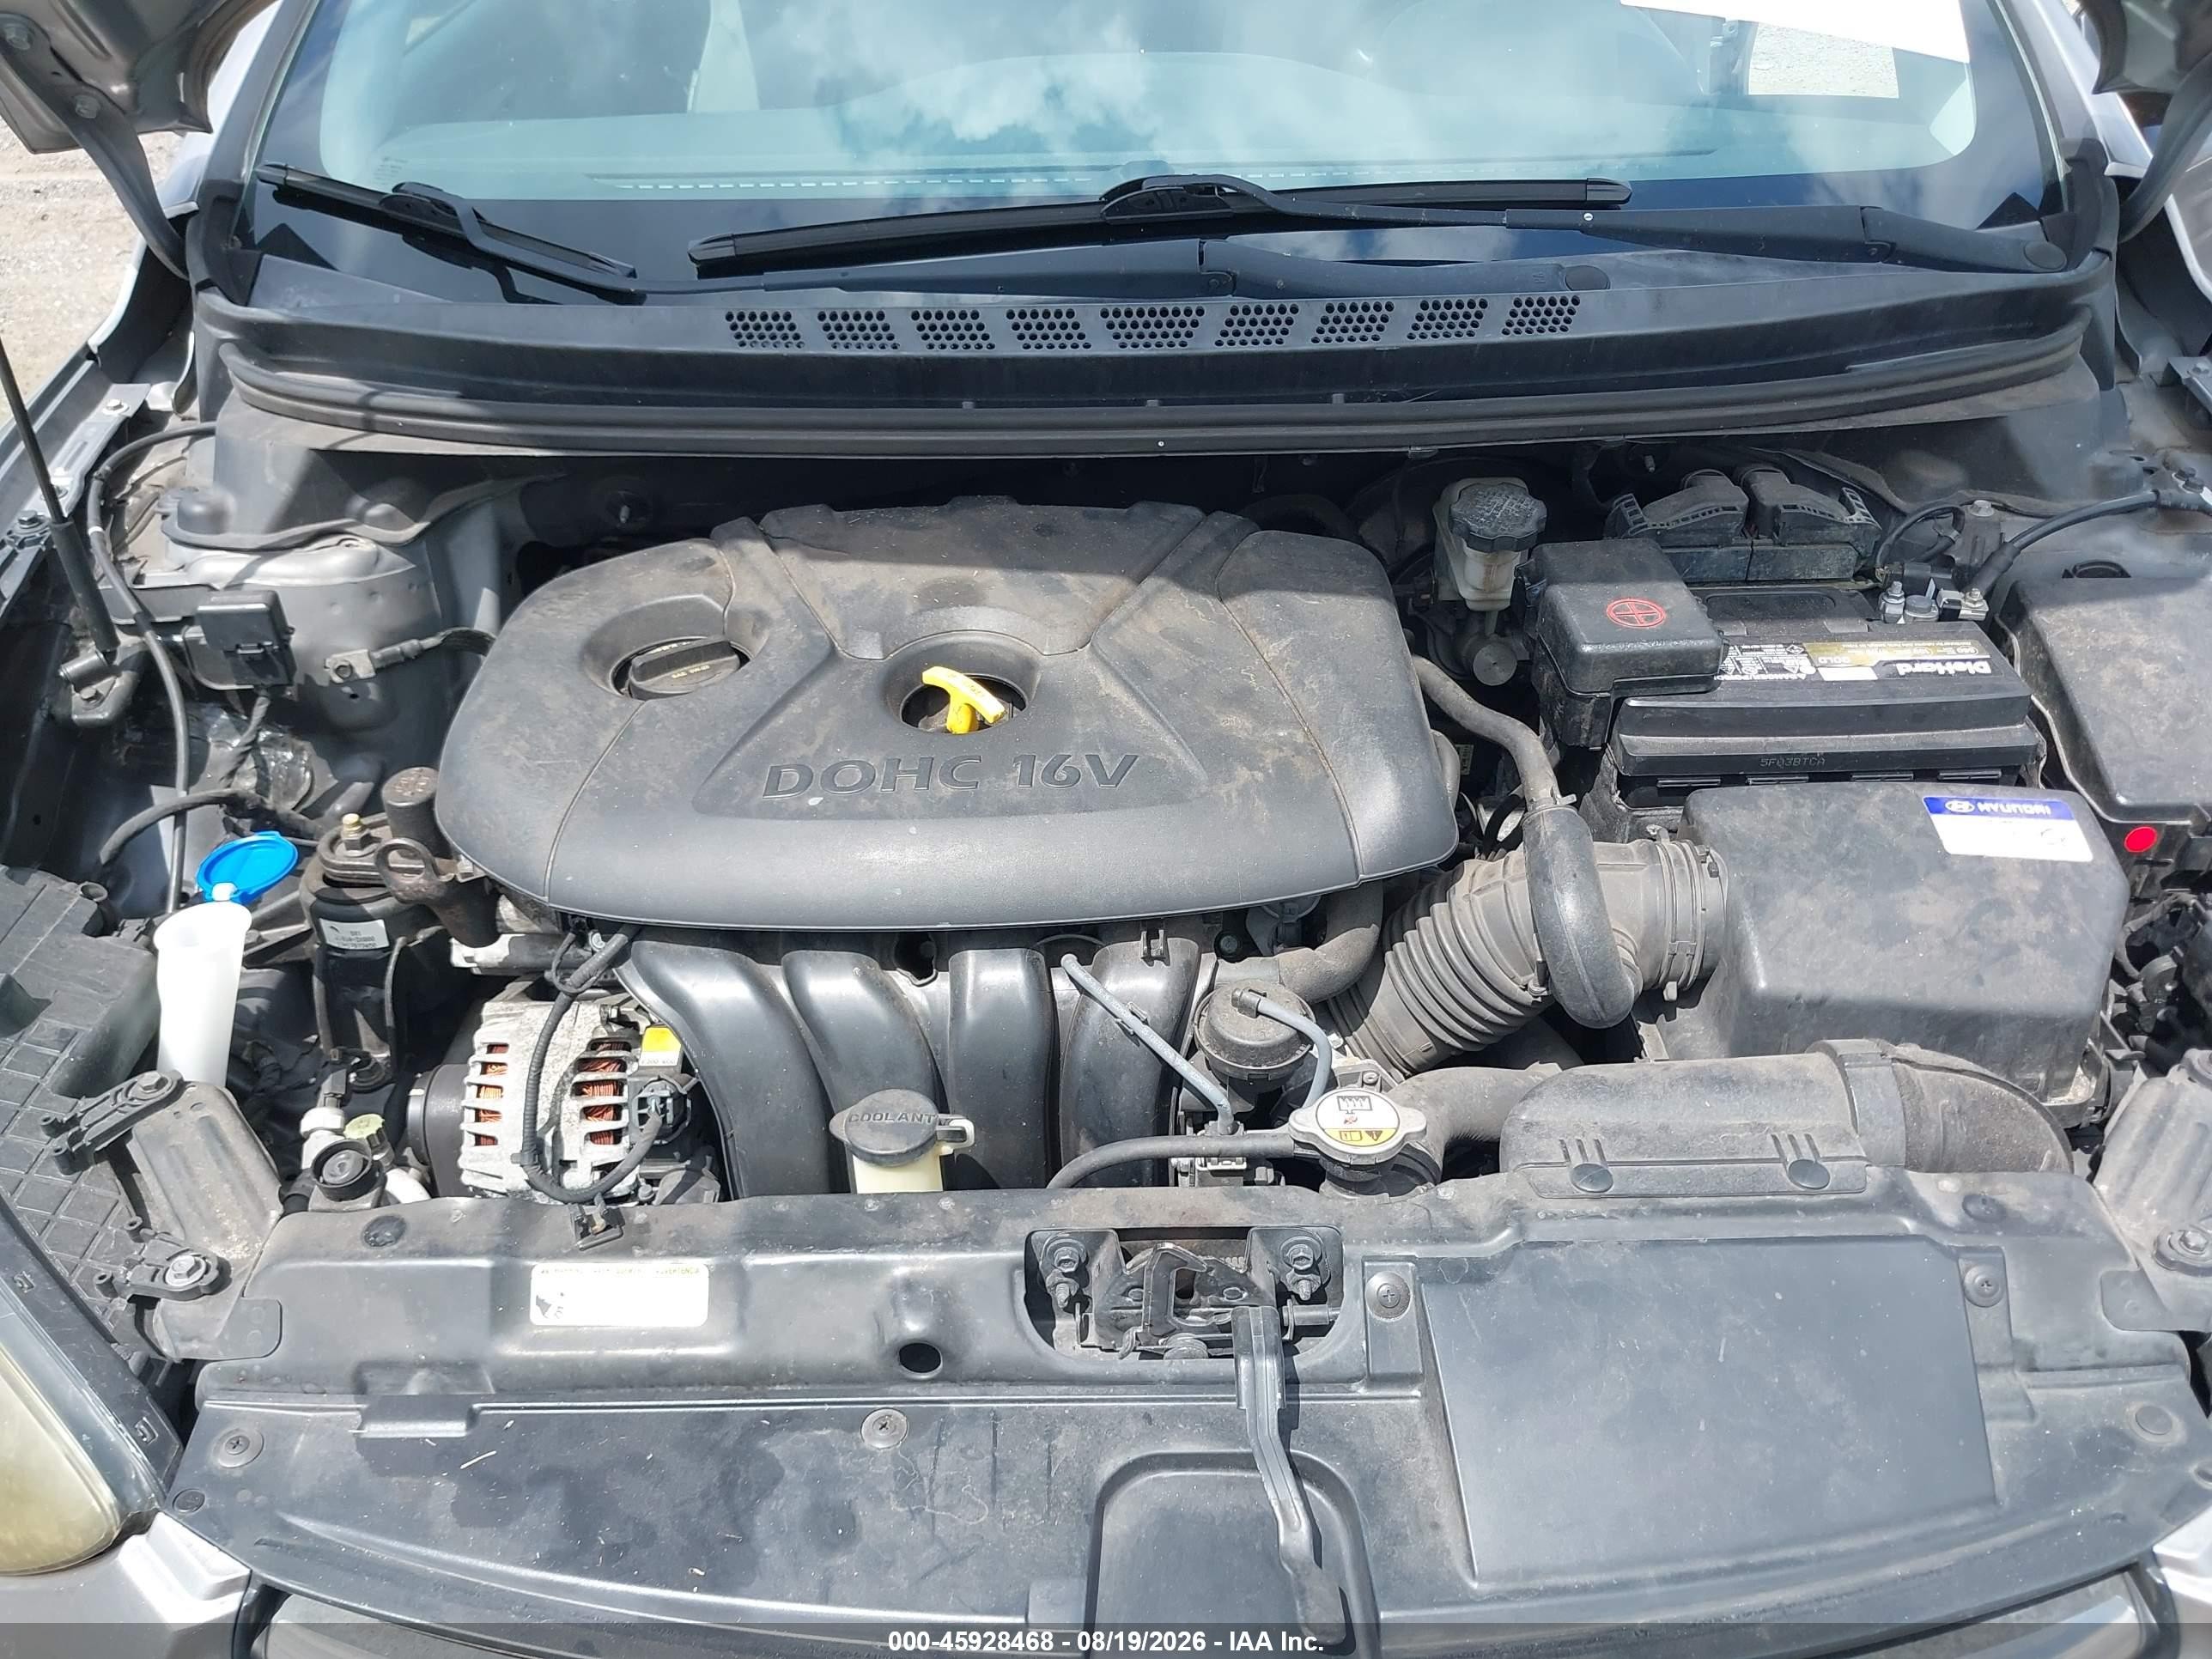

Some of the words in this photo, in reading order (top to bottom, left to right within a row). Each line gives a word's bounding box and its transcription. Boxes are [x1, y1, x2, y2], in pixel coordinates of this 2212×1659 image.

[1896, 660, 1991, 676] DieHard
[762, 755, 982, 799] DOHC
[1012, 753, 1139, 790] 16V
[1976, 802, 2051, 815] HYUNDAI
[848, 1112, 936, 1124] COOLANT
